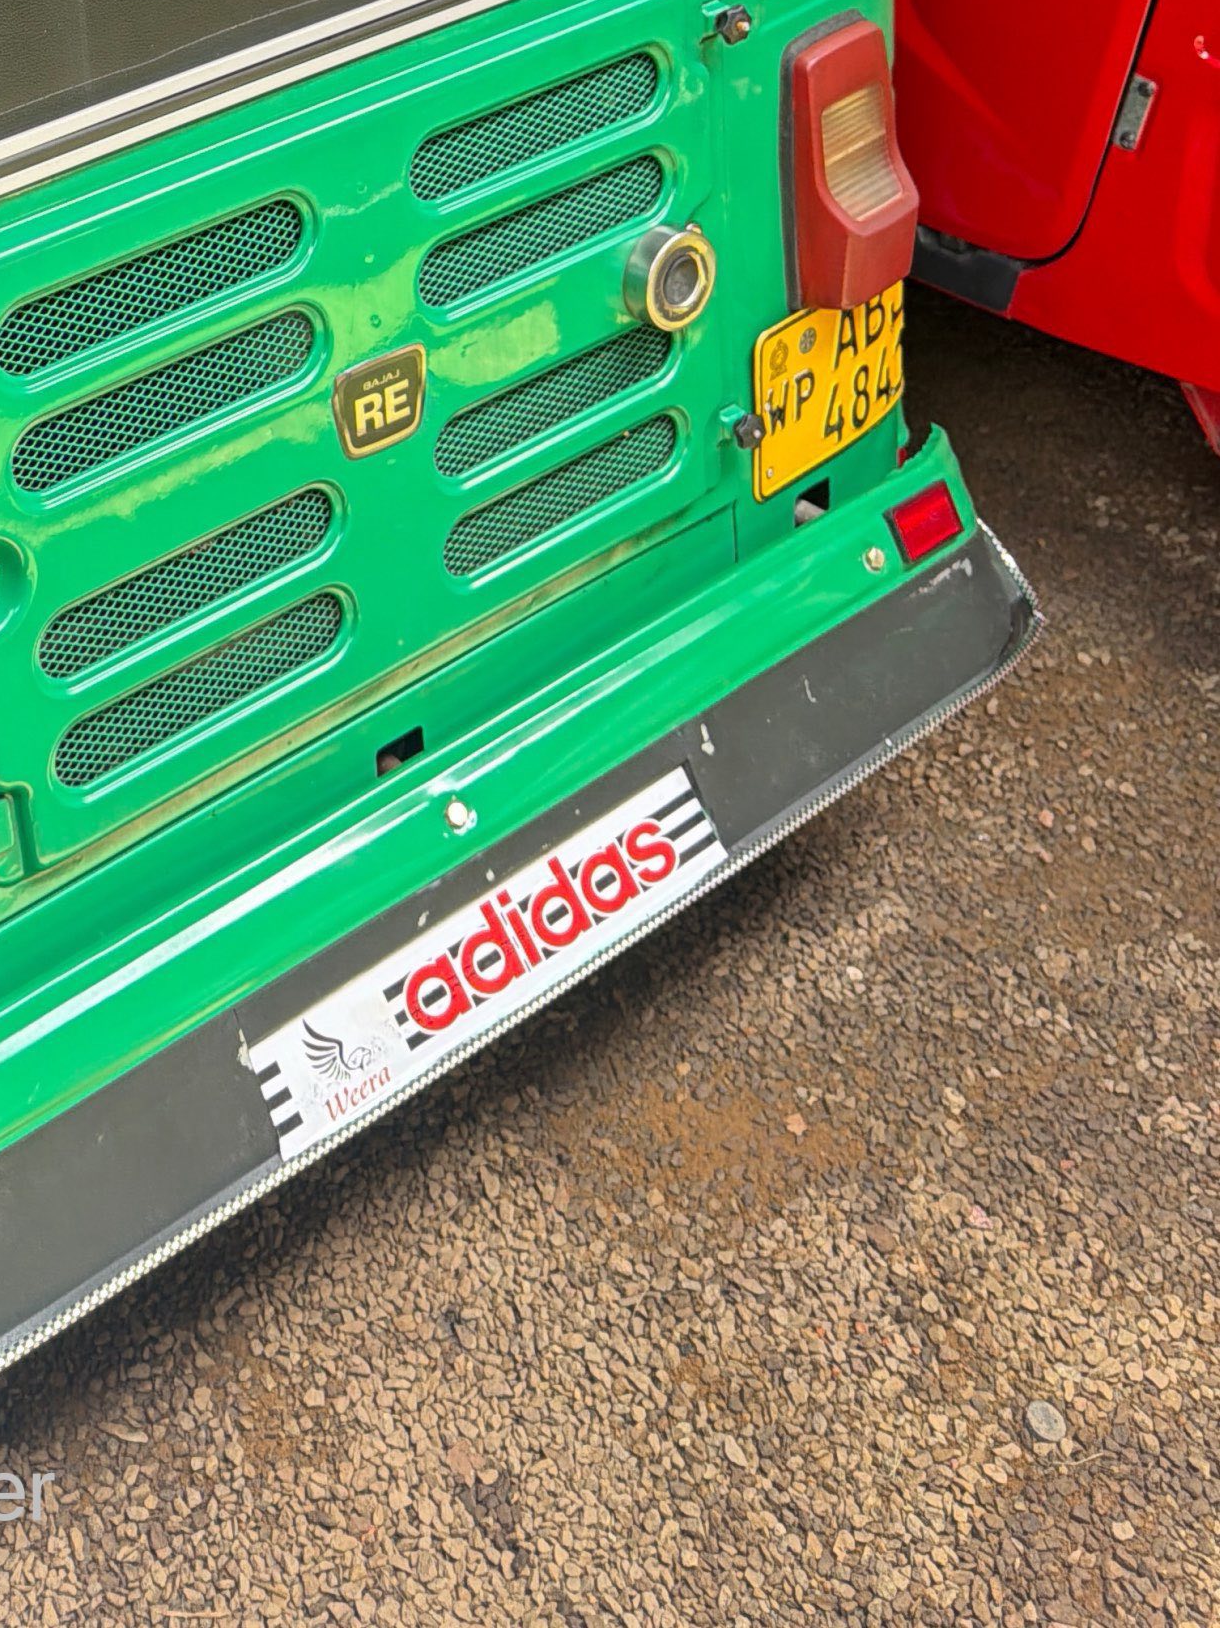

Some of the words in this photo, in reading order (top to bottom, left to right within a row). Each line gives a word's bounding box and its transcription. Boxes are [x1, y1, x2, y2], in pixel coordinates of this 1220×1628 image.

[355, 378, 411, 438] RE
[363, 369, 400, 391] BAJAJ
[766, 369, 815, 435] WP
[406, 822, 676, 1031] adidas
[324, 1066, 391, 1121] Weera
